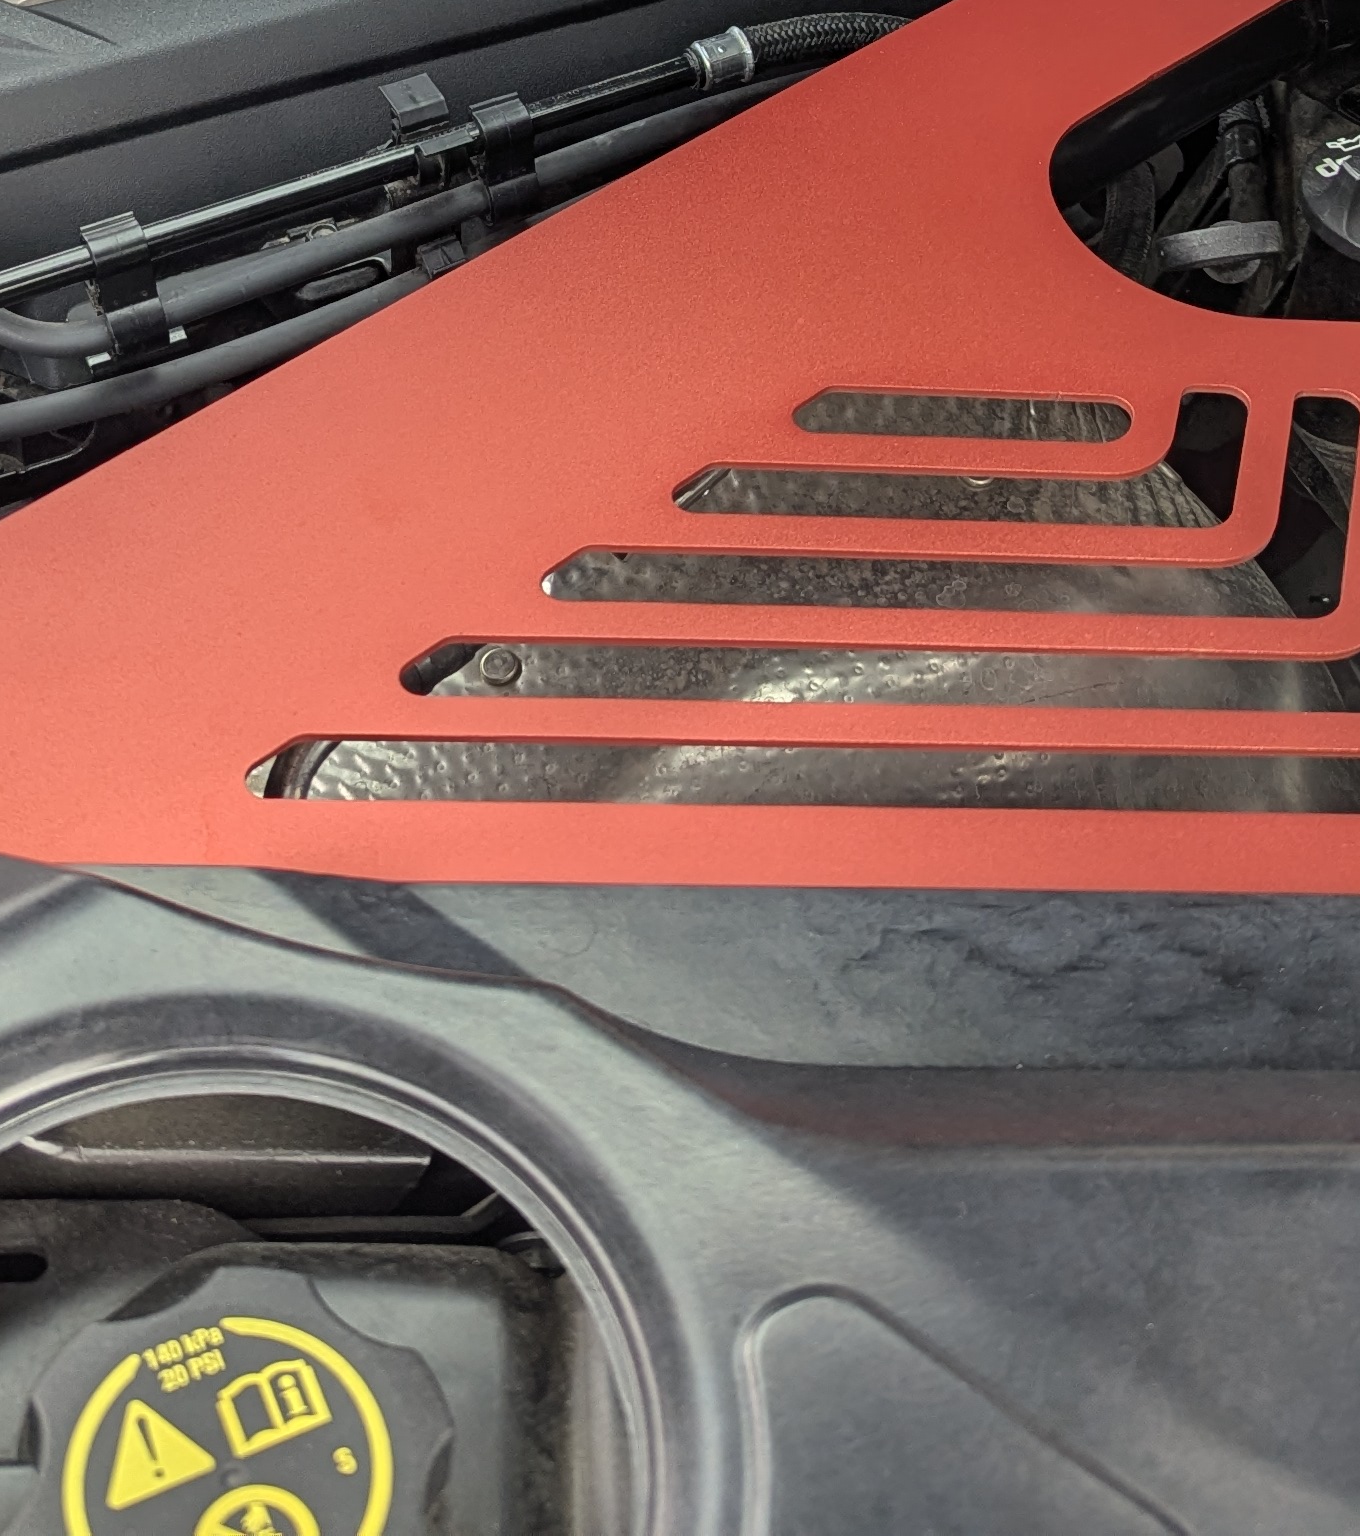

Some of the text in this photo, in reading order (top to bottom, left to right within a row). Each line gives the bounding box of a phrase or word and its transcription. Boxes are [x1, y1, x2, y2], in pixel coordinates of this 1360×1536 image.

[142, 1327, 225, 1371] 140 kPa
[157, 1348, 227, 1394] 20 PSI
